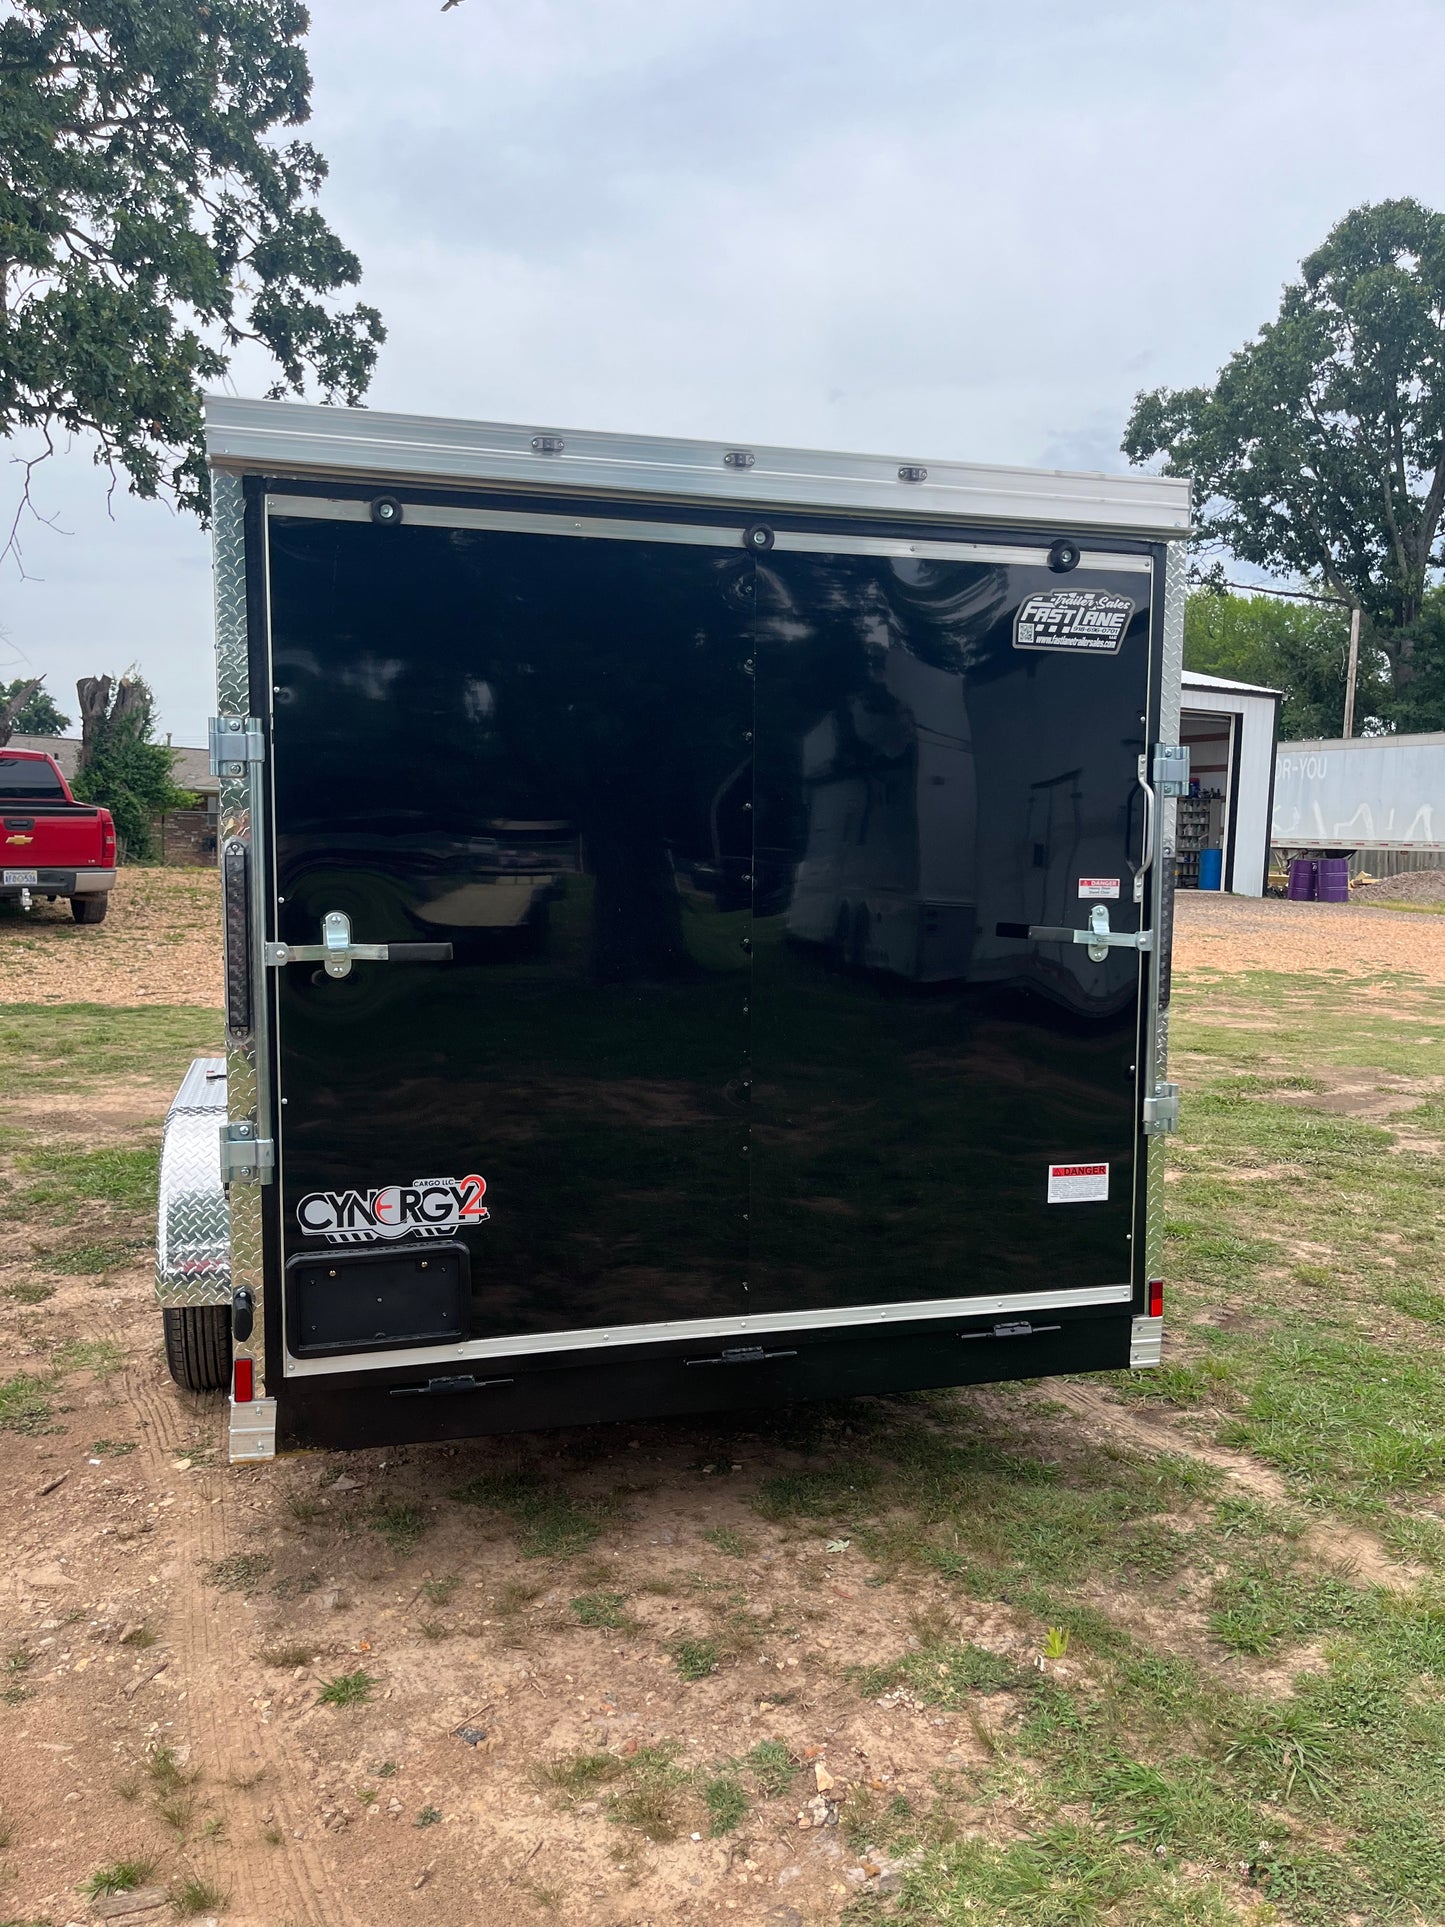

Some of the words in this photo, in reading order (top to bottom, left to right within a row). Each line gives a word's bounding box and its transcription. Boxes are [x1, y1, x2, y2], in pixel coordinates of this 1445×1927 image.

[1053, 592, 1095, 608] Trailer
[1096, 596, 1131, 610] Sales
[1020, 601, 1076, 624] FAST
[1071, 607, 1126, 628] LANE
[1035, 635, 1117, 649] www.fastlanetrailersales.com
[1064, 1166, 1107, 1176] DANGER
[413, 1178, 441, 1188] CARGO
[441, 1178, 454, 1186] LLC
